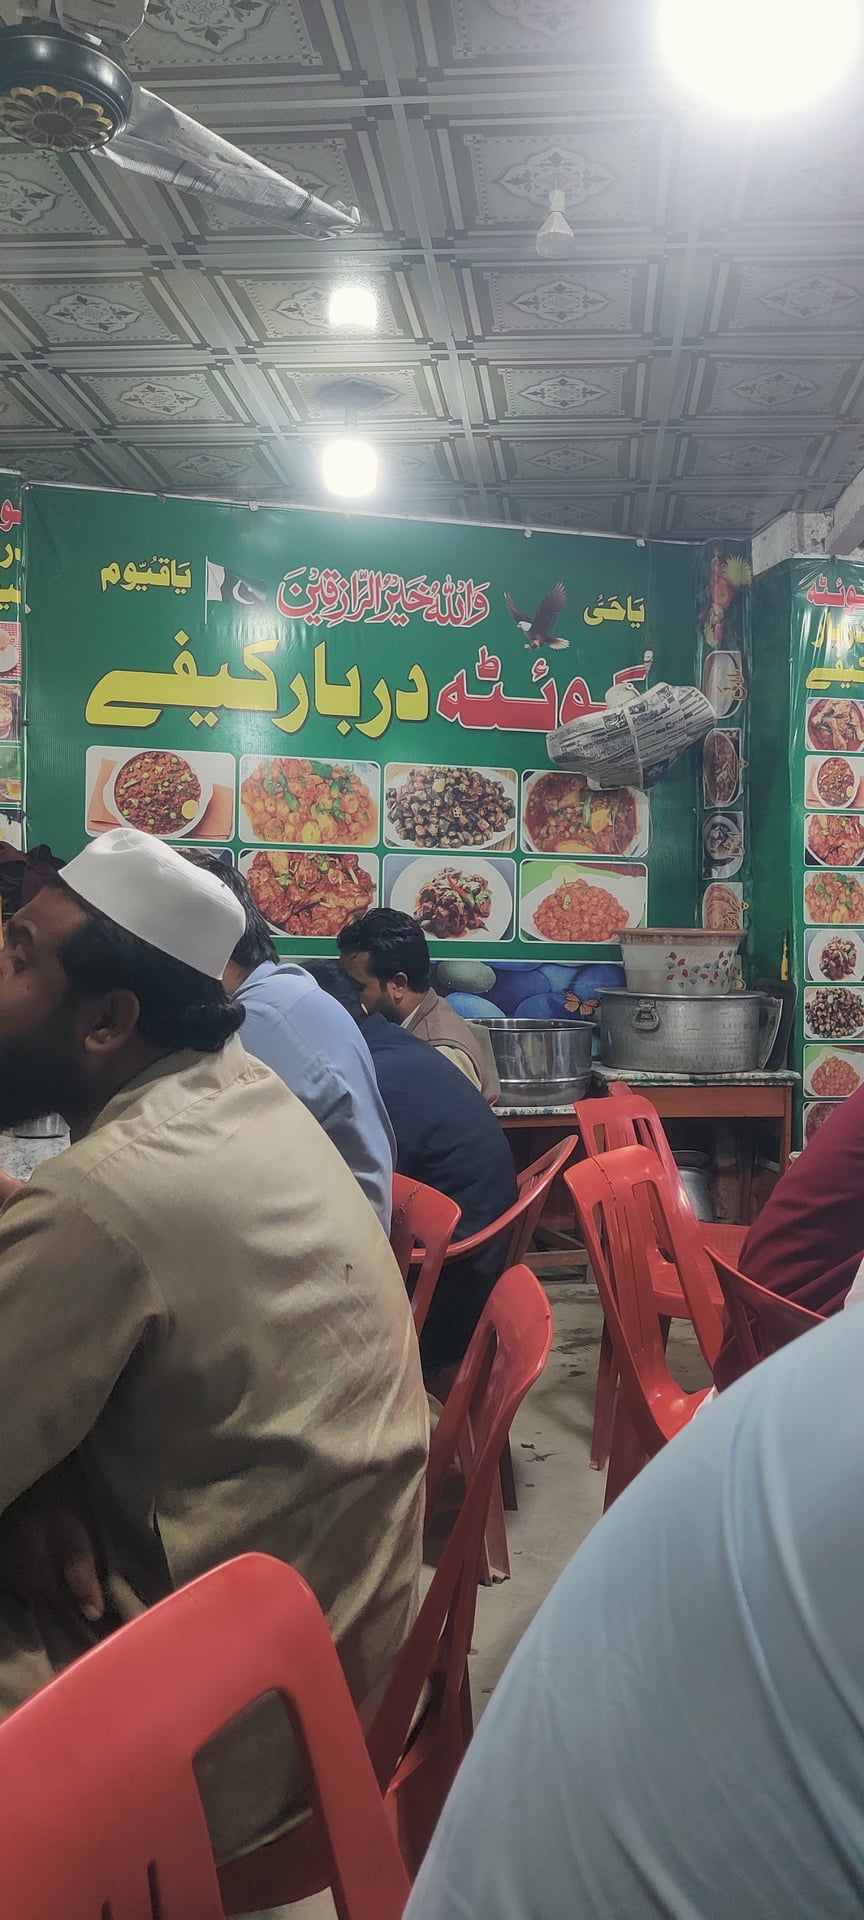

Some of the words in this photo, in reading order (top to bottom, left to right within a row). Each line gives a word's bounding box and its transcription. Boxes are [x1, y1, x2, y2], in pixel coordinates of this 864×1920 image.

[806, 573, 864, 615] وئٹہ
[85, 629, 280, 728] کیفے
[271, 640, 429, 738] دربار
